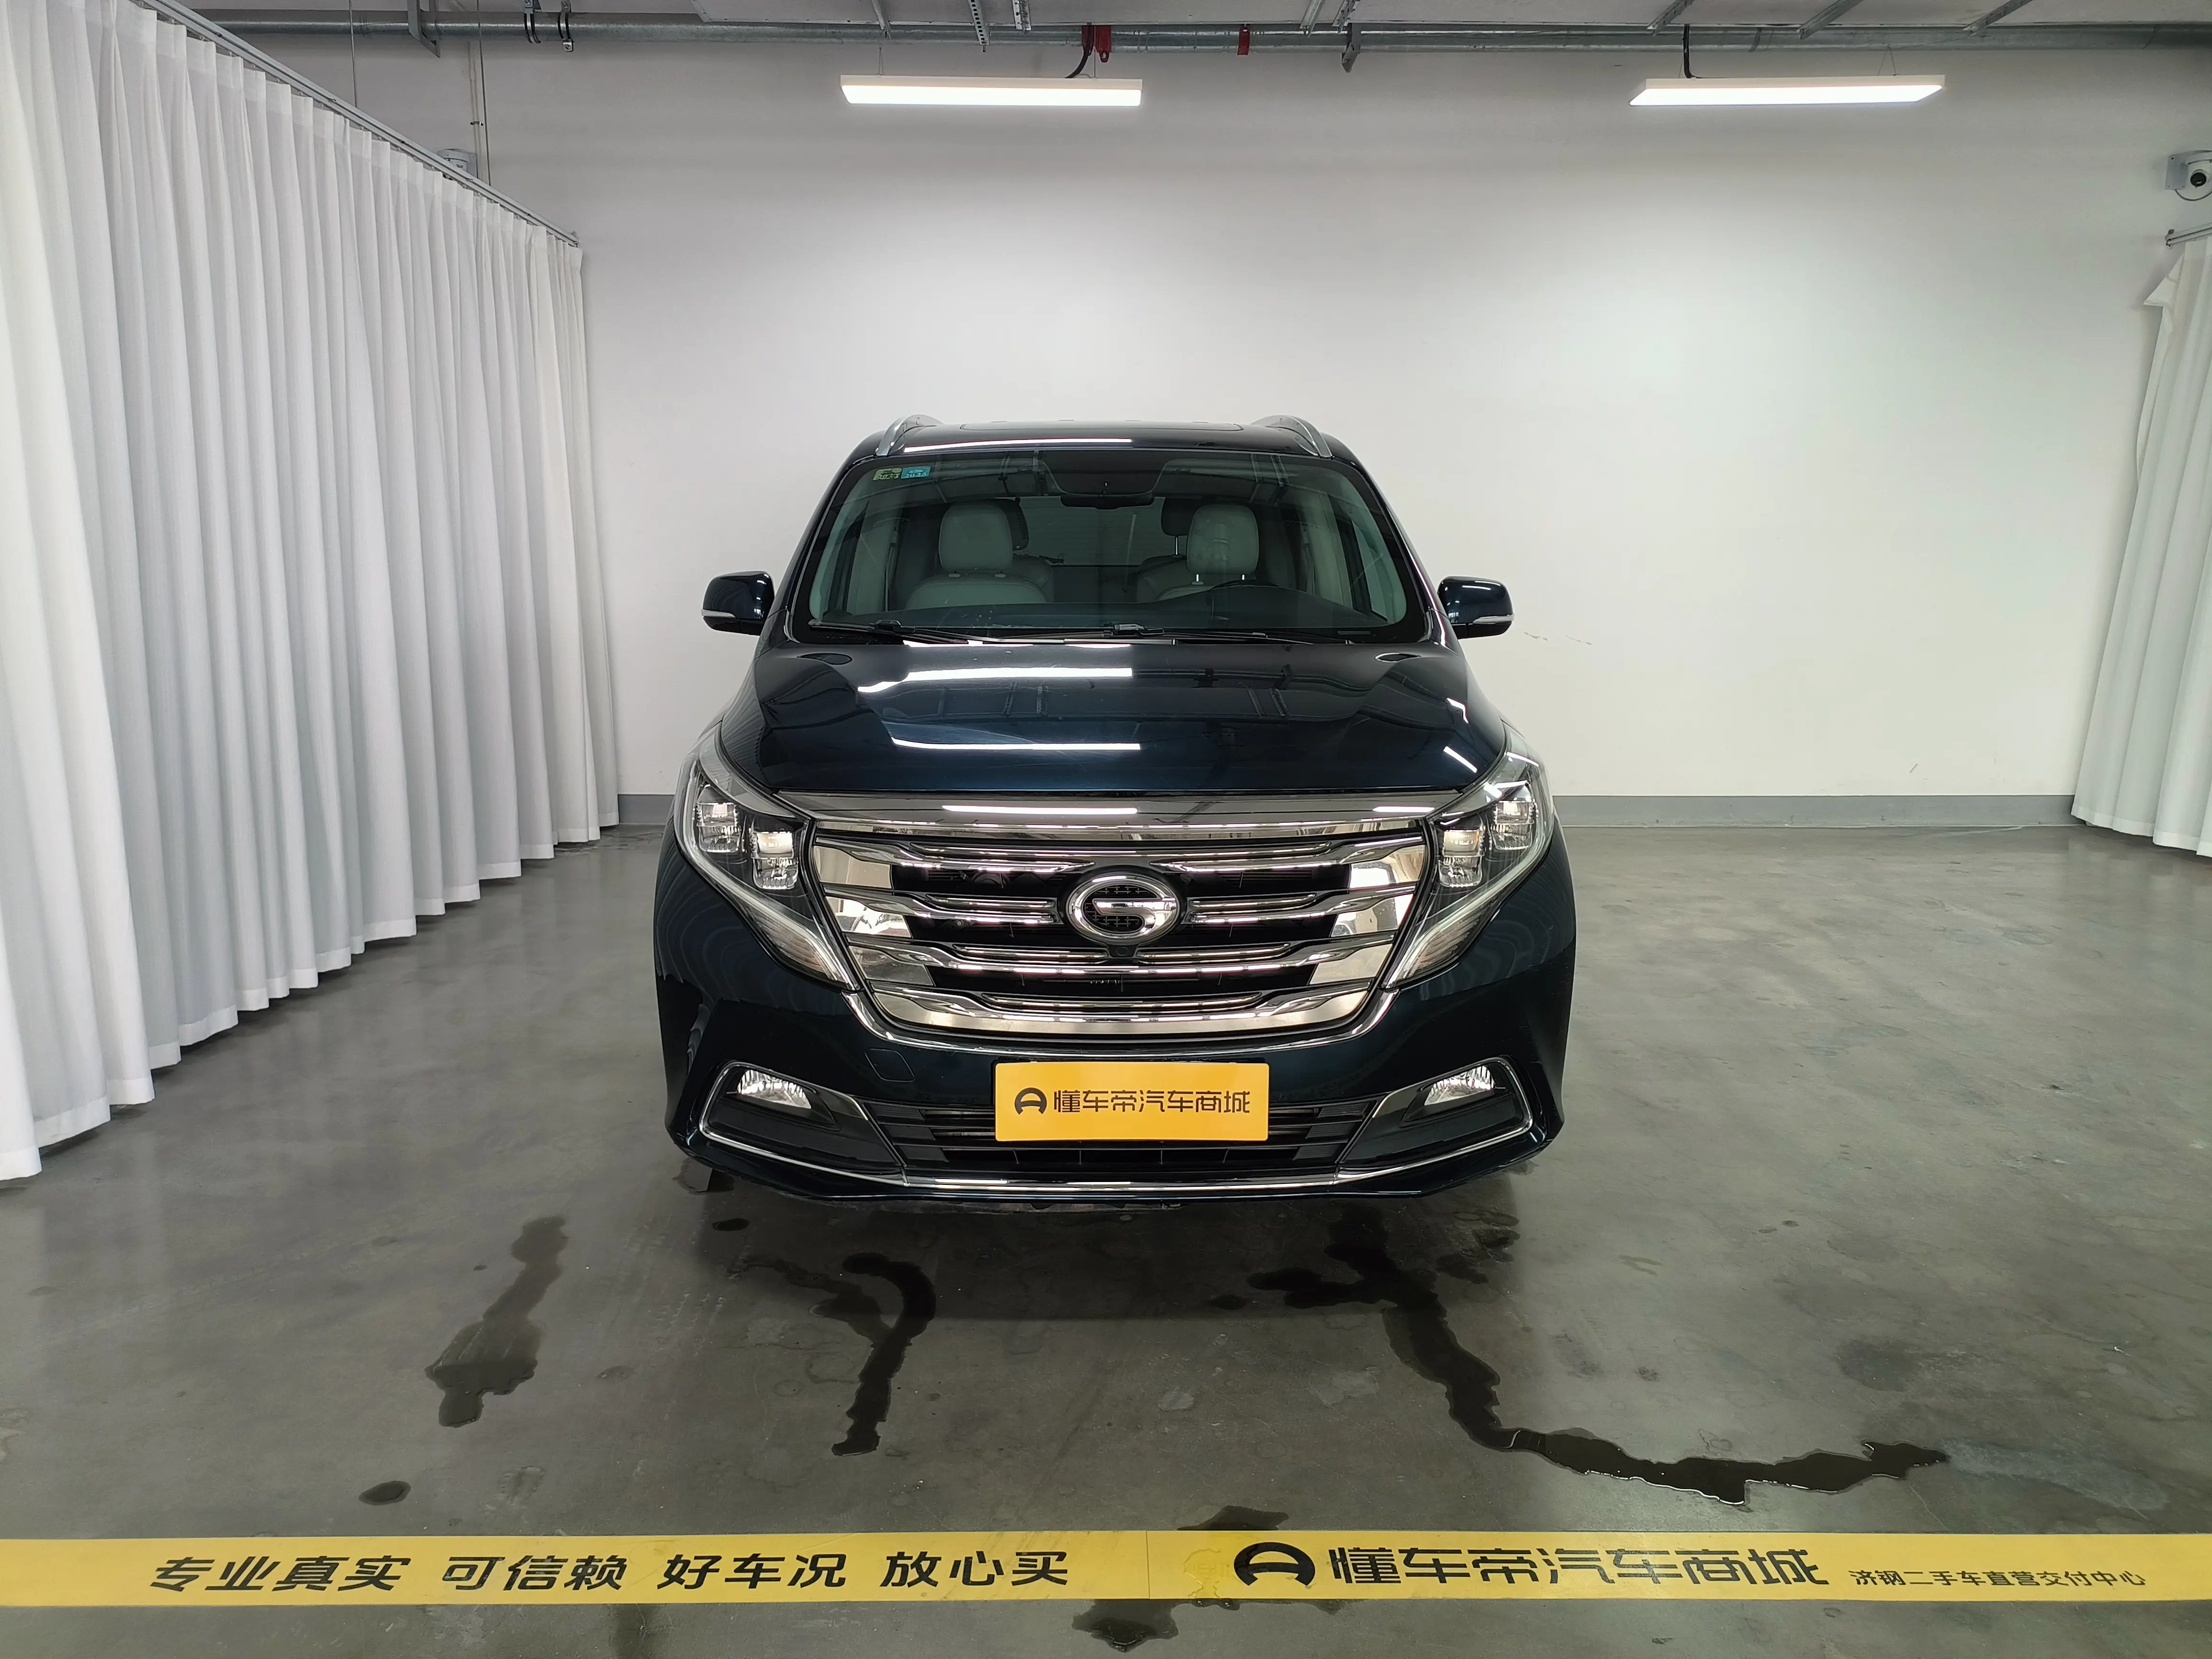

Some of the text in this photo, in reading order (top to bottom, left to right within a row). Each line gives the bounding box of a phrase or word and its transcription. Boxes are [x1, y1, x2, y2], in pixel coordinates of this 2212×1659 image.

[1054, 1090, 1250, 1113] 懂车帝汽车商城
[150, 1550, 1068, 1592] 专业真实 可信赖 好车况 放心买
[1328, 1547, 1829, 1585] 懂车帝汽车商城
[1848, 1570, 2146, 1586] 济钢二手车直营交付中心
